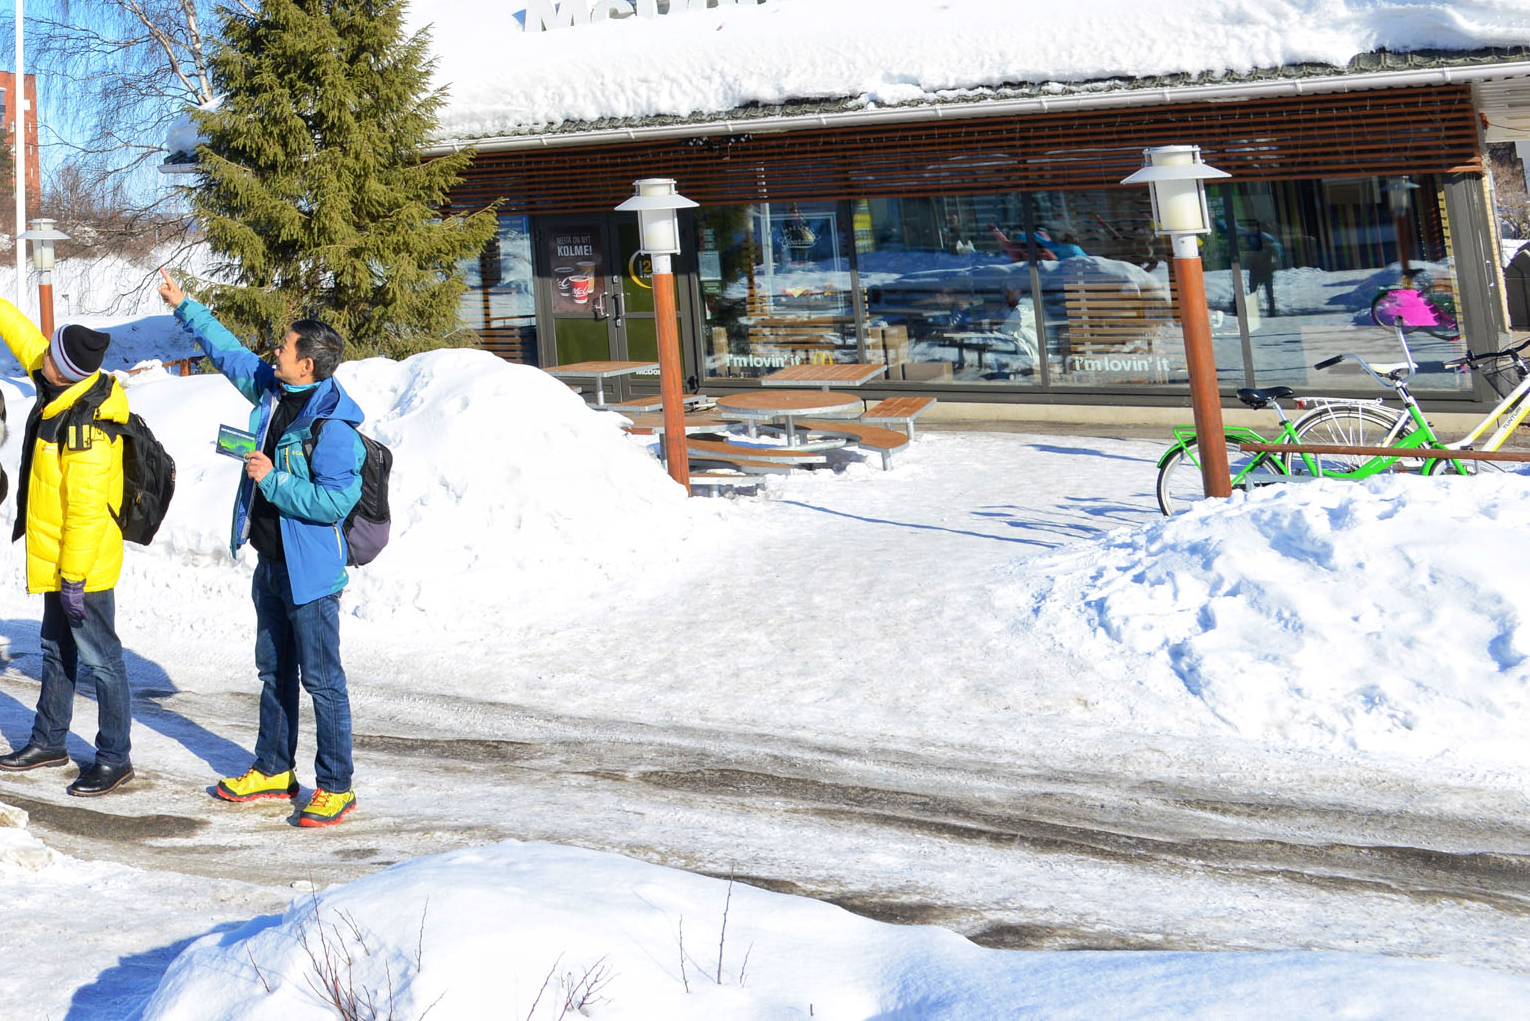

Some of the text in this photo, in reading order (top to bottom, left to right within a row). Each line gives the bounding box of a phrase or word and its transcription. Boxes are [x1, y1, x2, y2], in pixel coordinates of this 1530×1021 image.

[557, 245, 593, 257] KOLME!
[749, 354, 787, 368] lovin'
[790, 354, 802, 366] it
[1075, 356, 1170, 372] i'm lovin' it
[1502, 406, 1522, 429] TUNTURI
